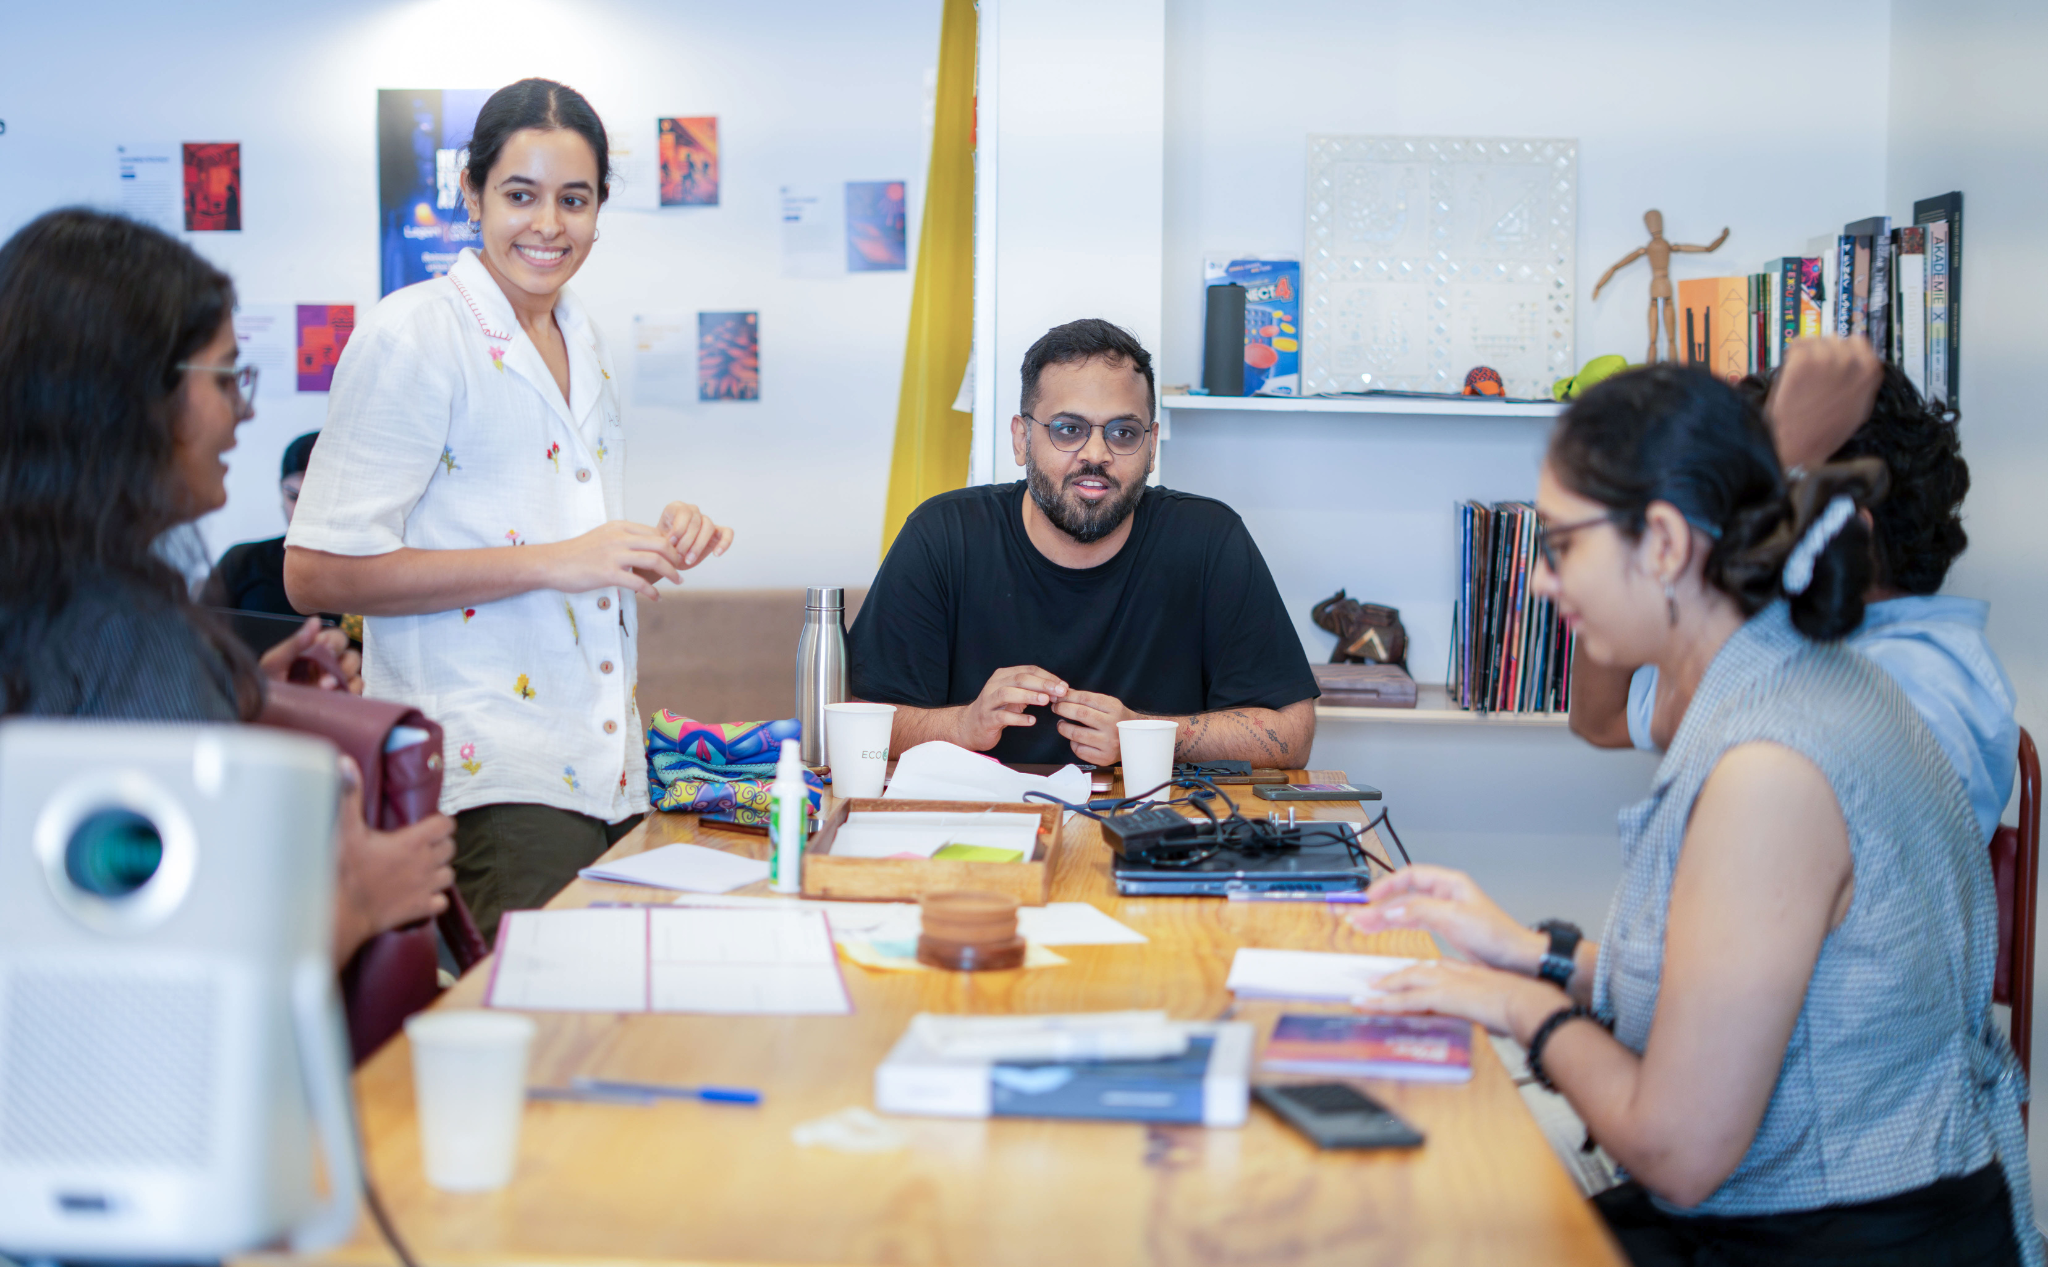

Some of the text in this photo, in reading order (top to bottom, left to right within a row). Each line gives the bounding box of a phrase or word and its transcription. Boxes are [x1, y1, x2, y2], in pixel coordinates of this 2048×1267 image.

[1933, 236, 1946, 305] AKADEMIE
[1275, 278, 1291, 299] 4
[1784, 271, 1797, 321] EXQUISITE
[1933, 311, 1945, 321] X
[861, 750, 882, 760] ECO
